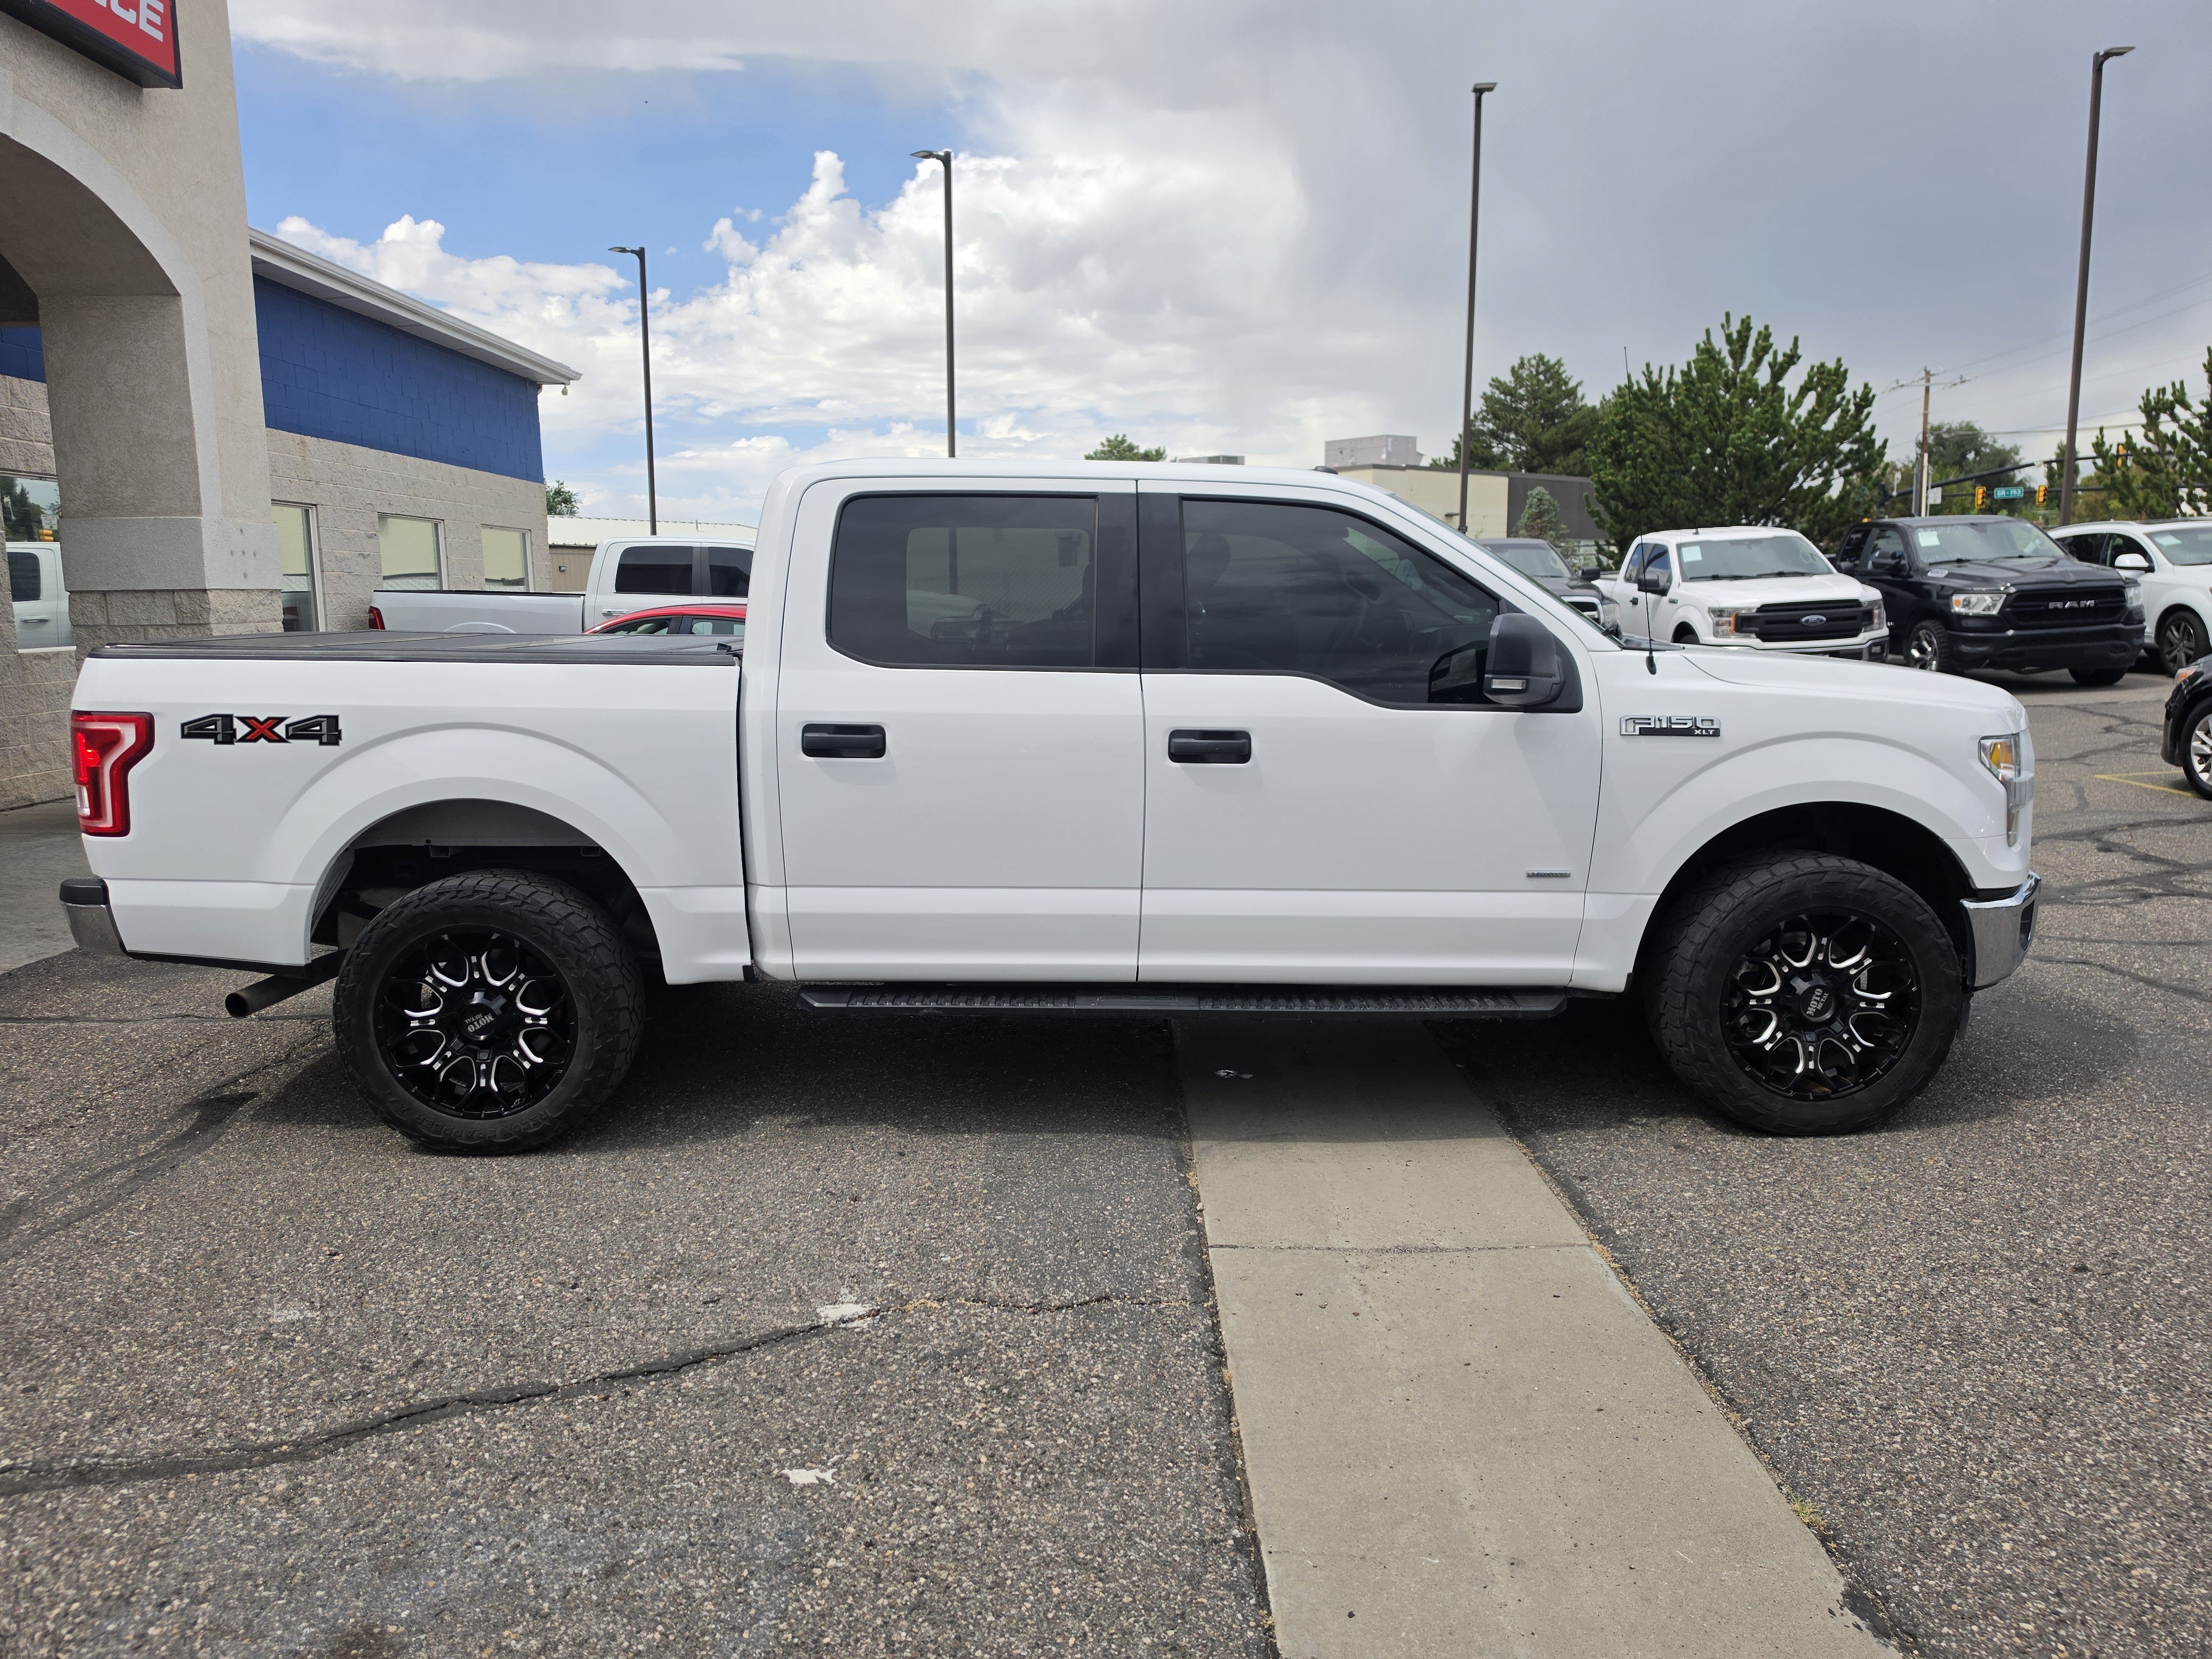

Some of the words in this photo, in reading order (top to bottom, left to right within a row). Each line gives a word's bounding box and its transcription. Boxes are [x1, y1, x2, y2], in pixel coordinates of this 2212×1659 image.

[95, 0, 164, 42] CE
[2048, 600, 2095, 609] RAM
[1620, 714, 1721, 735] F150
[1806, 988, 1823, 1016] MOTO
[1816, 992, 1829, 1011] METAL
[463, 1013, 483, 1024] METAL
[467, 1013, 495, 1032] MOTO
